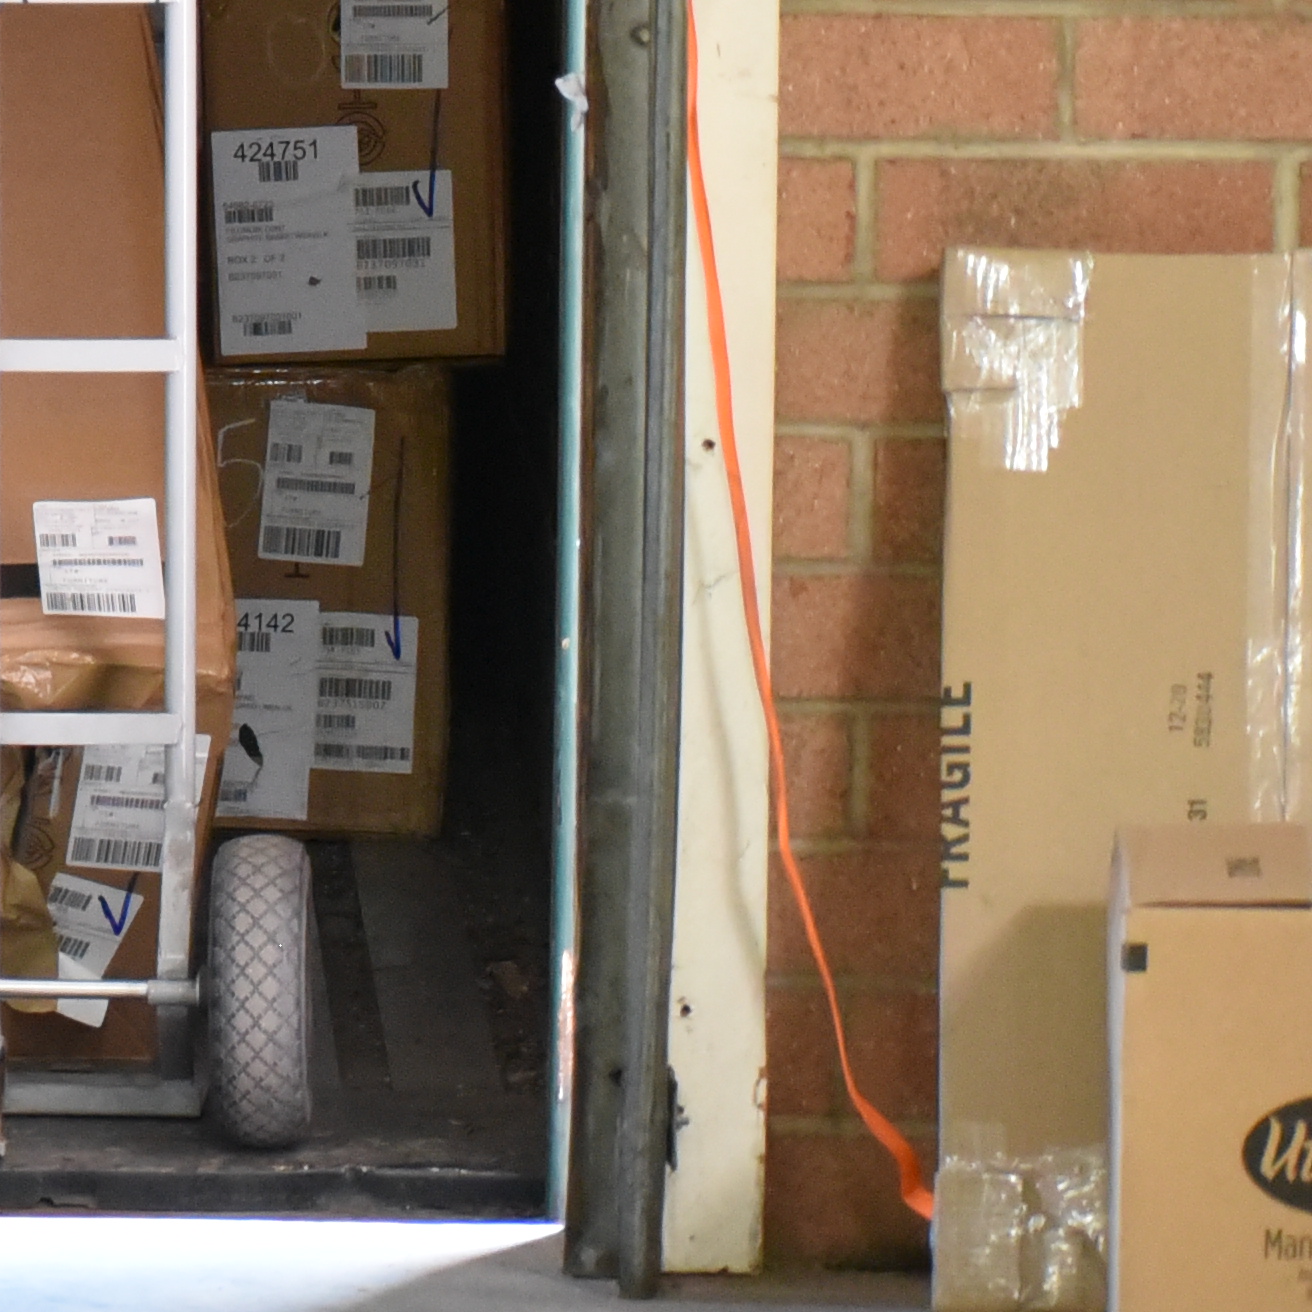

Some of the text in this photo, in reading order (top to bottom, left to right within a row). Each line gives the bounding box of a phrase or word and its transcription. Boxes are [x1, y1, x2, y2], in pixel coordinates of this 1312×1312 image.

[233, 139, 318, 163] 424751
[237, 612, 295, 634] 4142
[941, 681, 972, 890] FRAGILE
[1188, 799, 1208, 821] 31
